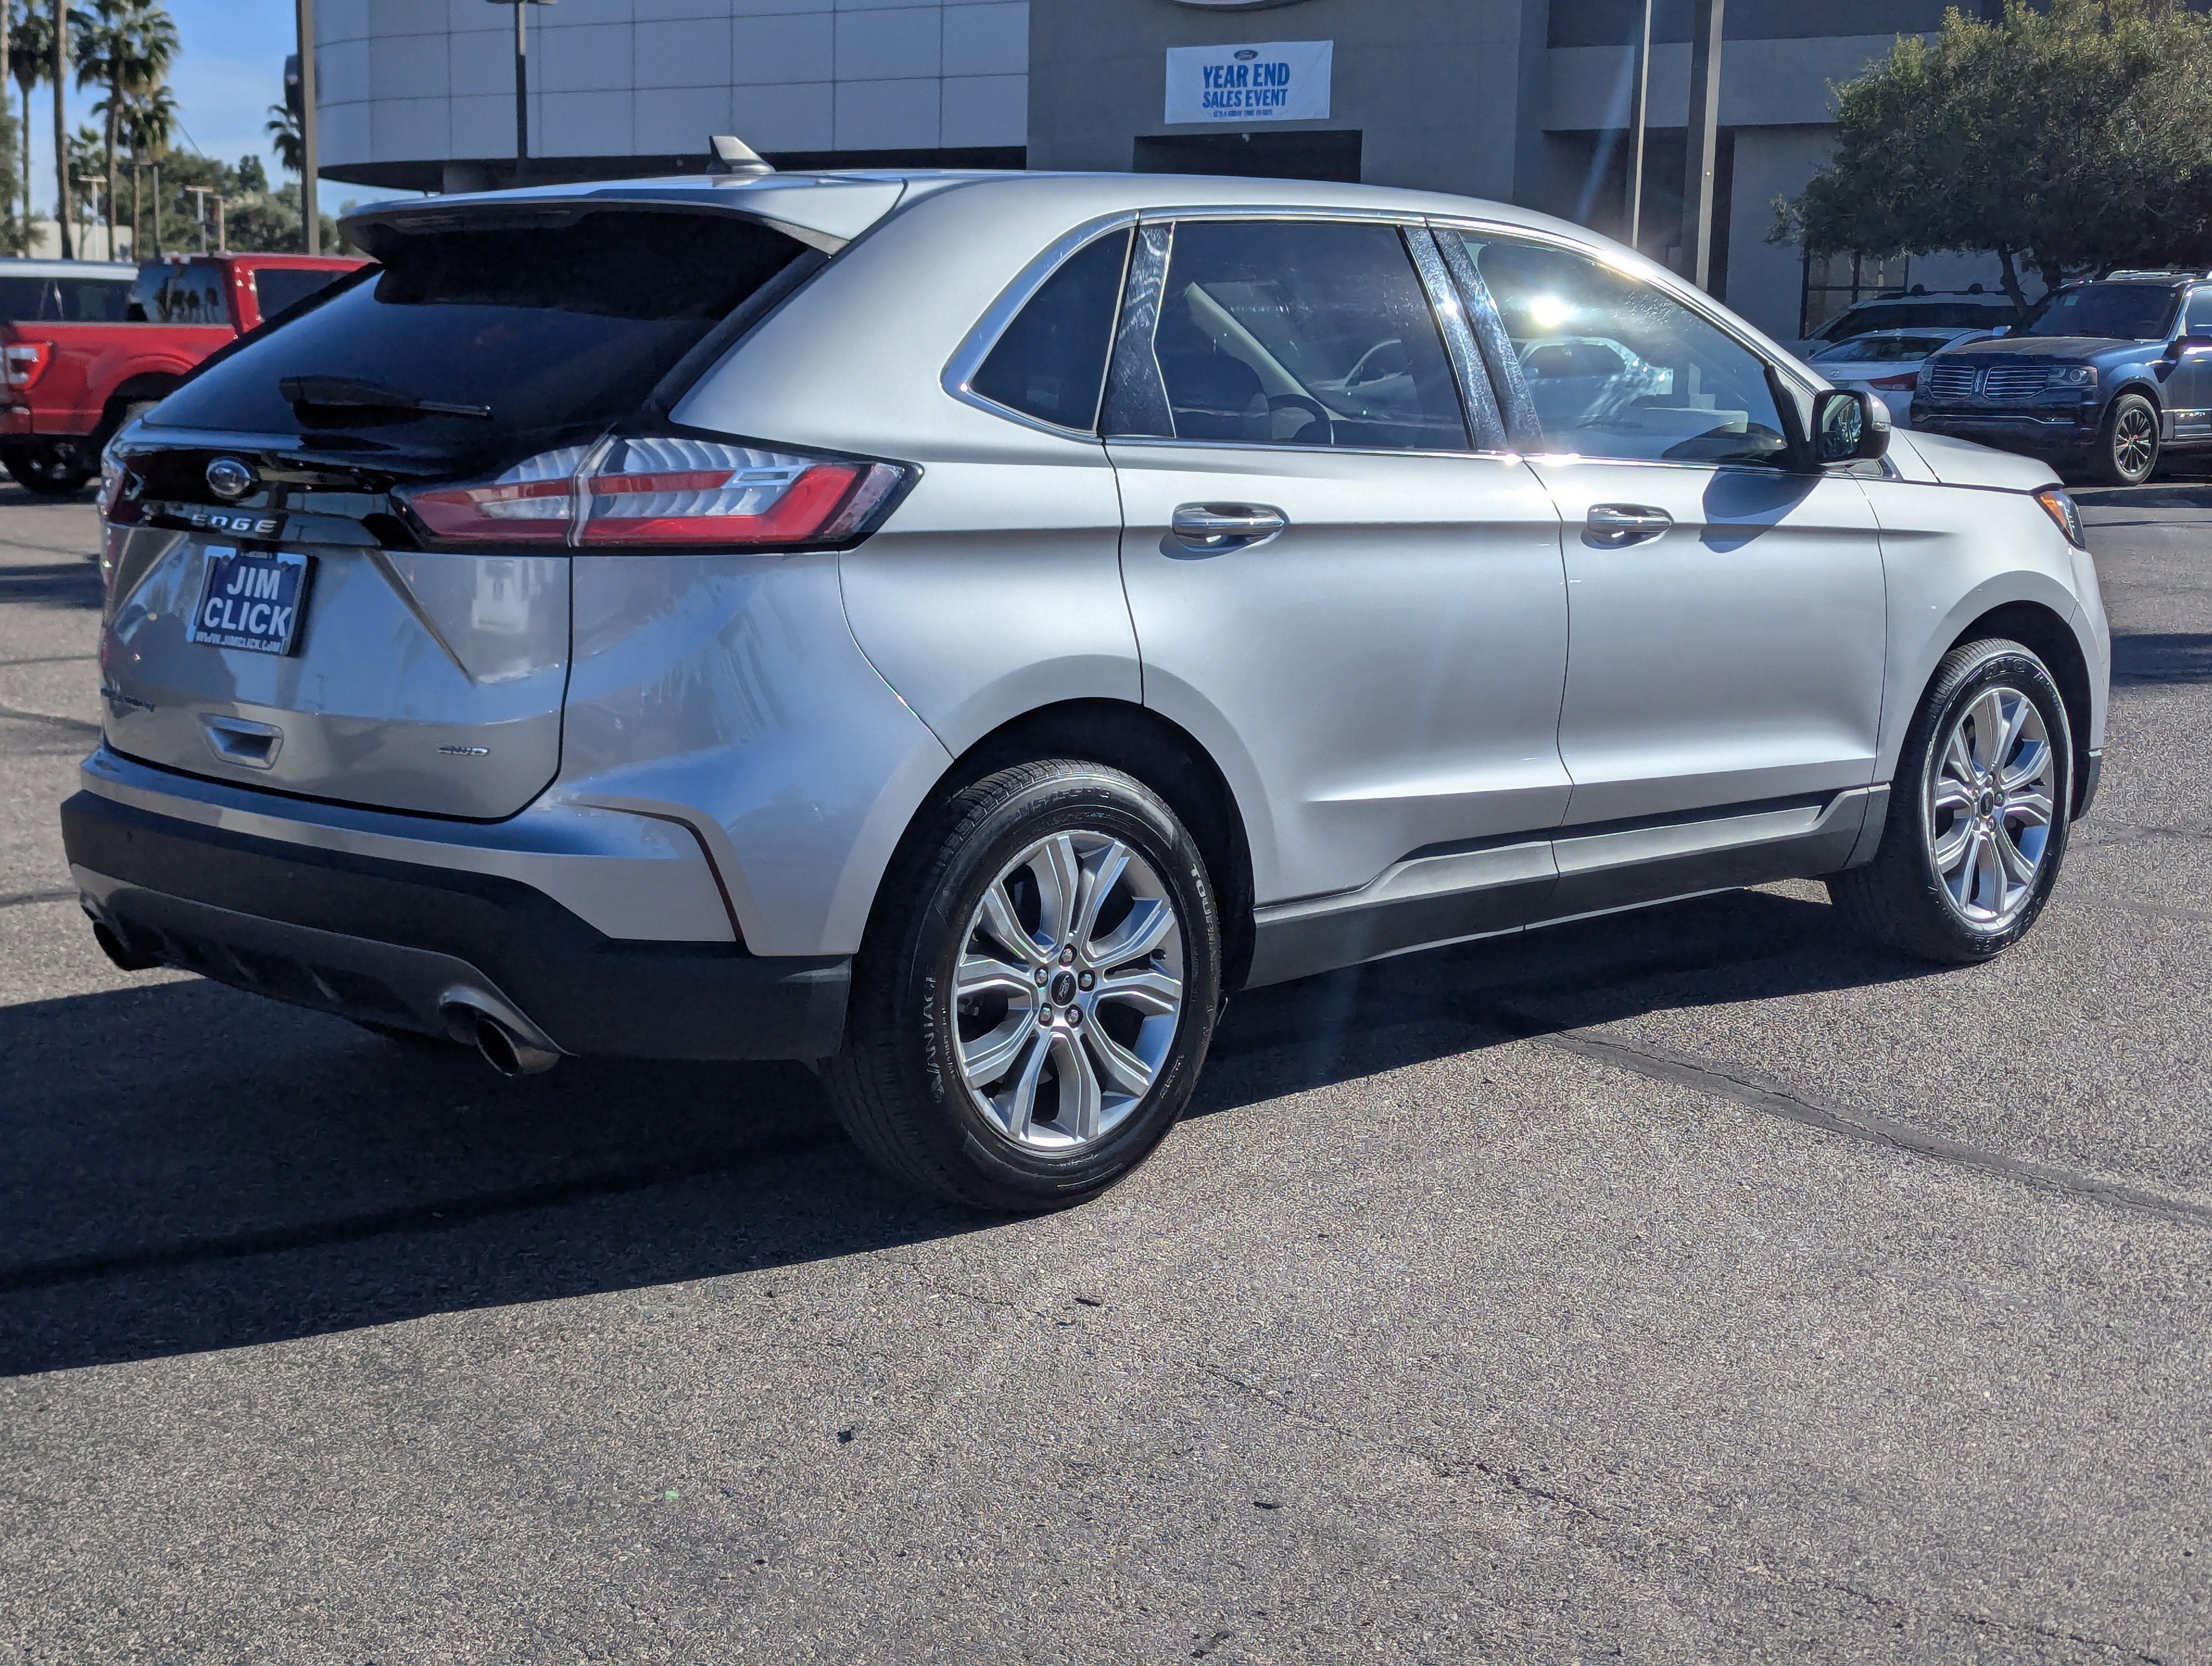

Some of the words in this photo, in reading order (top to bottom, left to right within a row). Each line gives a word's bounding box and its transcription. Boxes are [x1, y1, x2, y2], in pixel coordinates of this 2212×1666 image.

[1203, 65, 1249, 89] YEAR
[1253, 62, 1290, 87] END
[1202, 90, 1242, 108] SALES
[1245, 88, 1288, 107] EVENT
[191, 514, 278, 534] EDGE
[227, 566, 281, 600] JIM
[204, 597, 293, 637] CLICK
